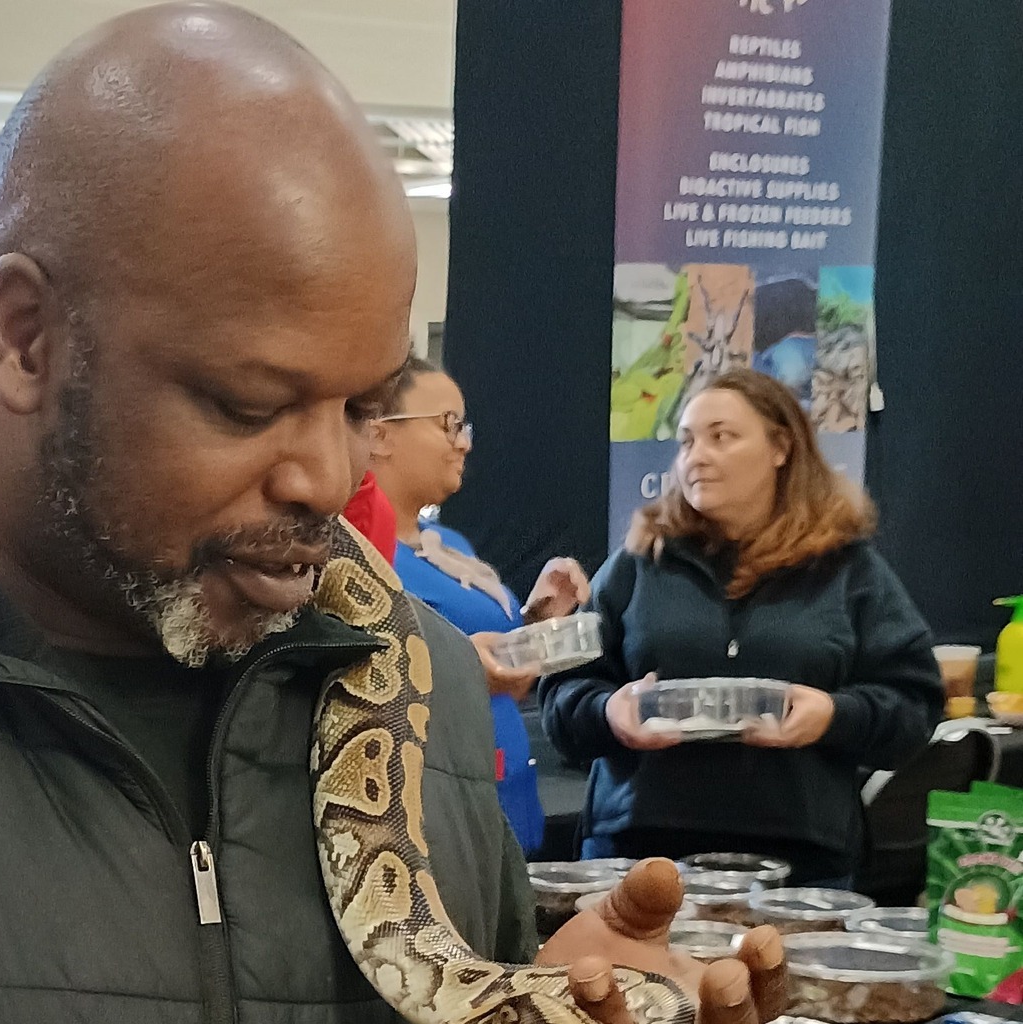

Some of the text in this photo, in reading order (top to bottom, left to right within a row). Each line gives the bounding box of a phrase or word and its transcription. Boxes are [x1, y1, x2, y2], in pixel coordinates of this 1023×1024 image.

[729, 34, 802, 59] REPTILES
[714, 60, 814, 86] AMPHIBIANS
[703, 111, 821, 137] TROPICAL FISH
[679, 176, 839, 201] BIOACTIVE SUPPLIES
[663, 202, 852, 226] LIVE & FROZEN FEEDERS
[685, 228, 828, 250] LIVE FISHING BAIT
